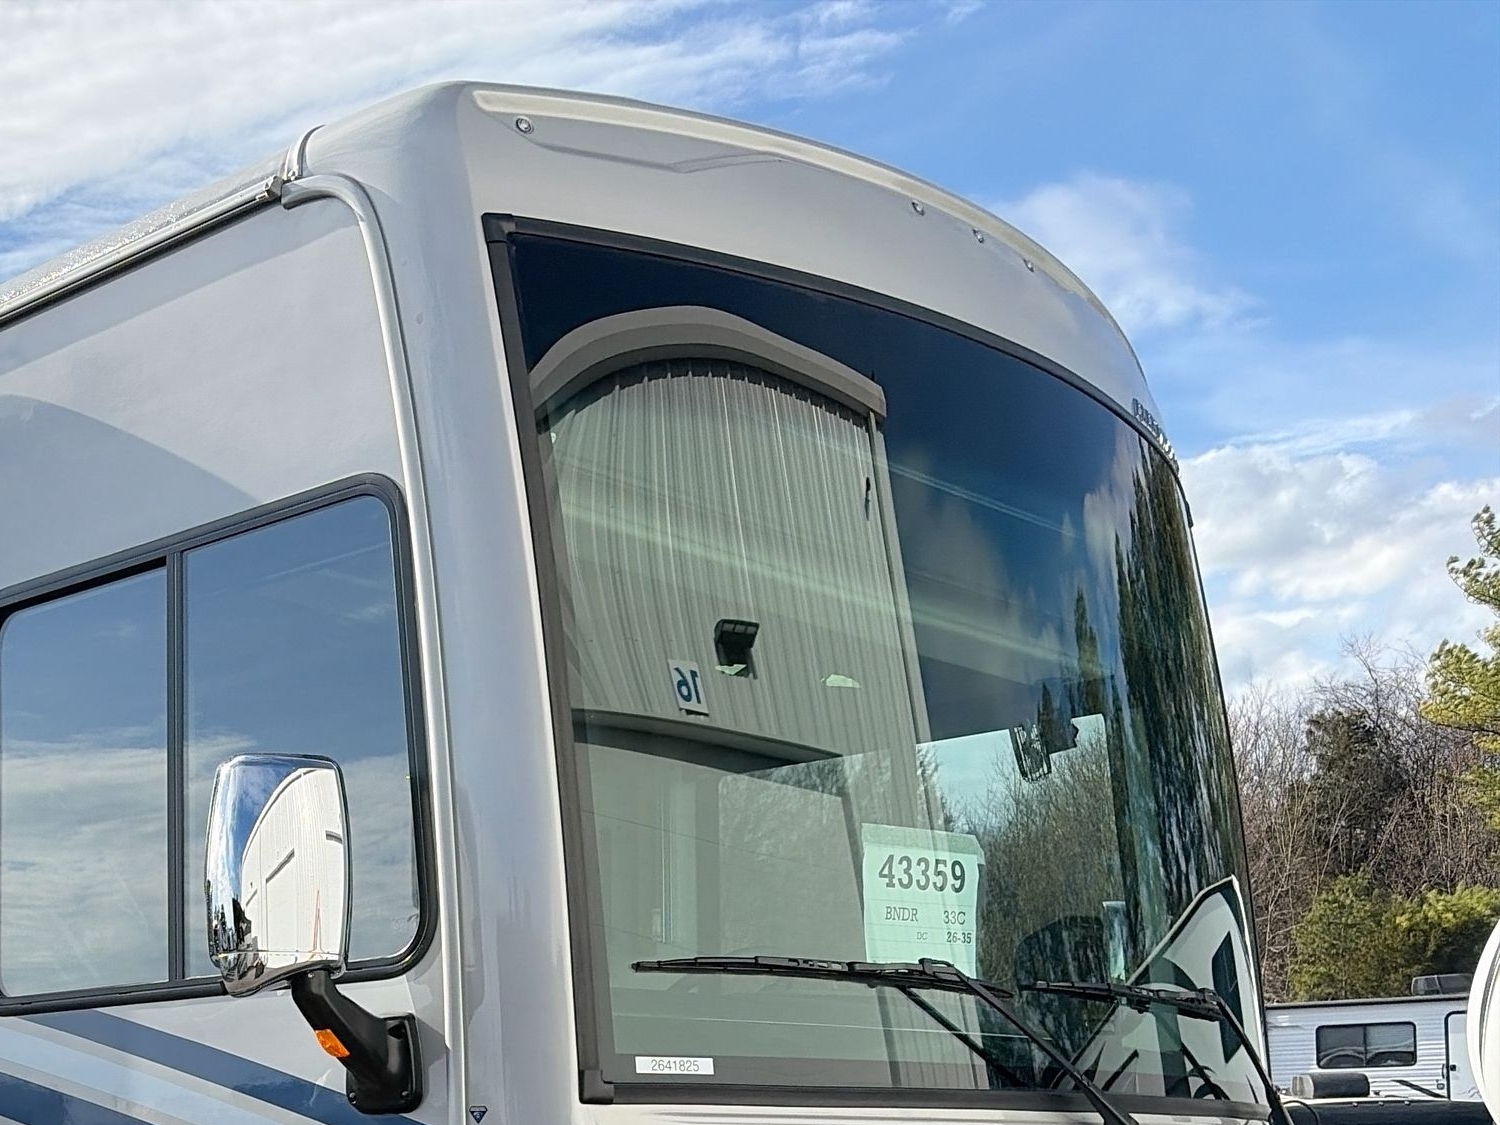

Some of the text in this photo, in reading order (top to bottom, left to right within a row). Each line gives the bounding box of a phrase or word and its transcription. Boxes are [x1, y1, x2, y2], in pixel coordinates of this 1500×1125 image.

[878, 854, 966, 893] 43359
[885, 906, 966, 925] BNDR 33C
[946, 931, 973, 944] 26-35
[650, 1059, 700, 1072] 2641825
